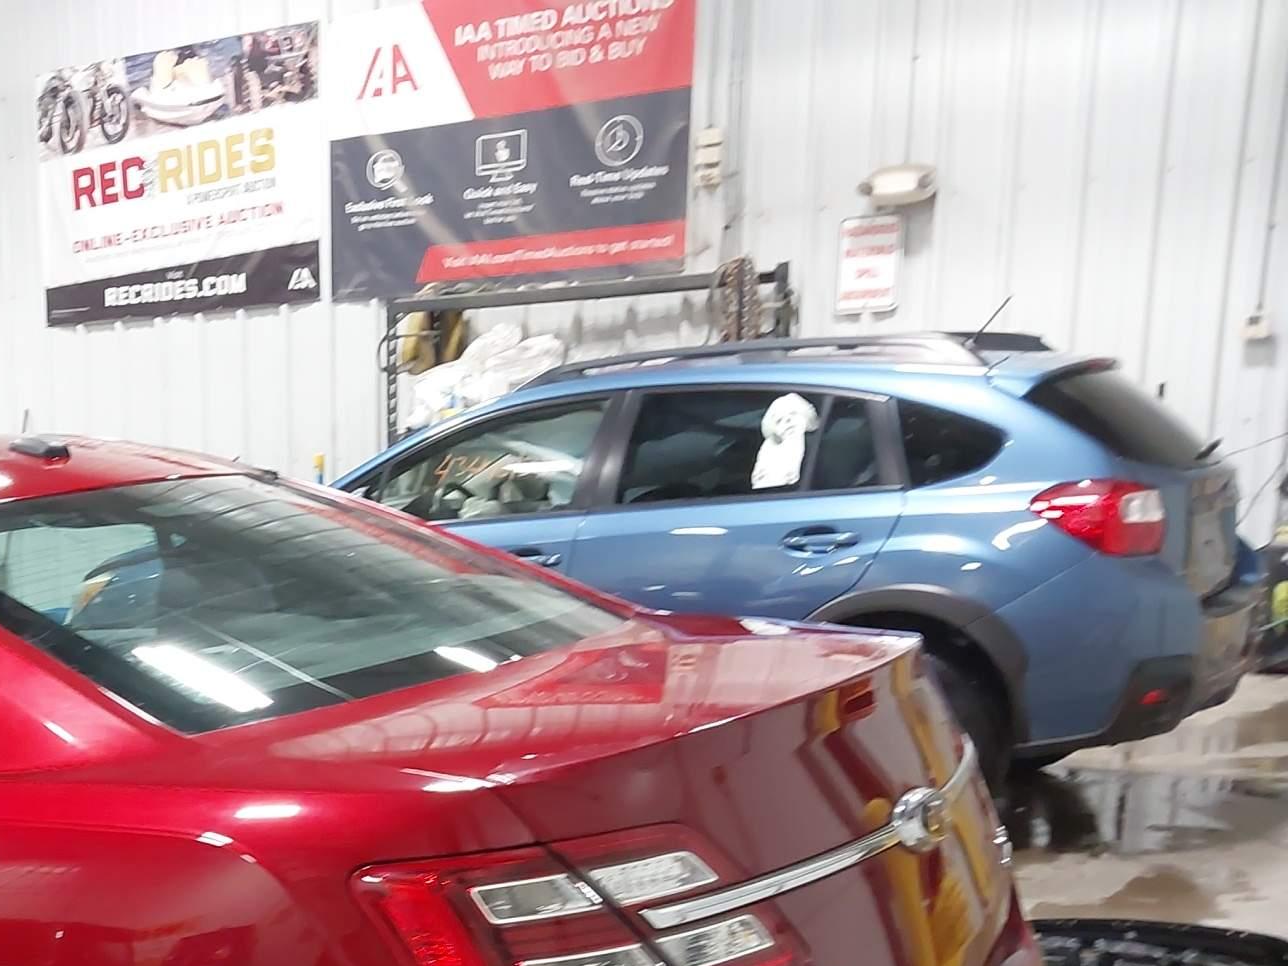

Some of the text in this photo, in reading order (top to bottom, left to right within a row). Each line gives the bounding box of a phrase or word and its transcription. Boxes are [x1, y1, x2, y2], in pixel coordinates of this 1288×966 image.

[455, 21, 493, 46] IAA
[495, 9, 558, 39] TIMED
[477, 14, 662, 62] INTRODUCING A NEW
[488, 36, 648, 80] WAY TO BID & BUY
[73, 127, 276, 210] REC RIDES
[218, 201, 284, 225] AUCTION
[103, 272, 247, 307] RECRIDES.COM
